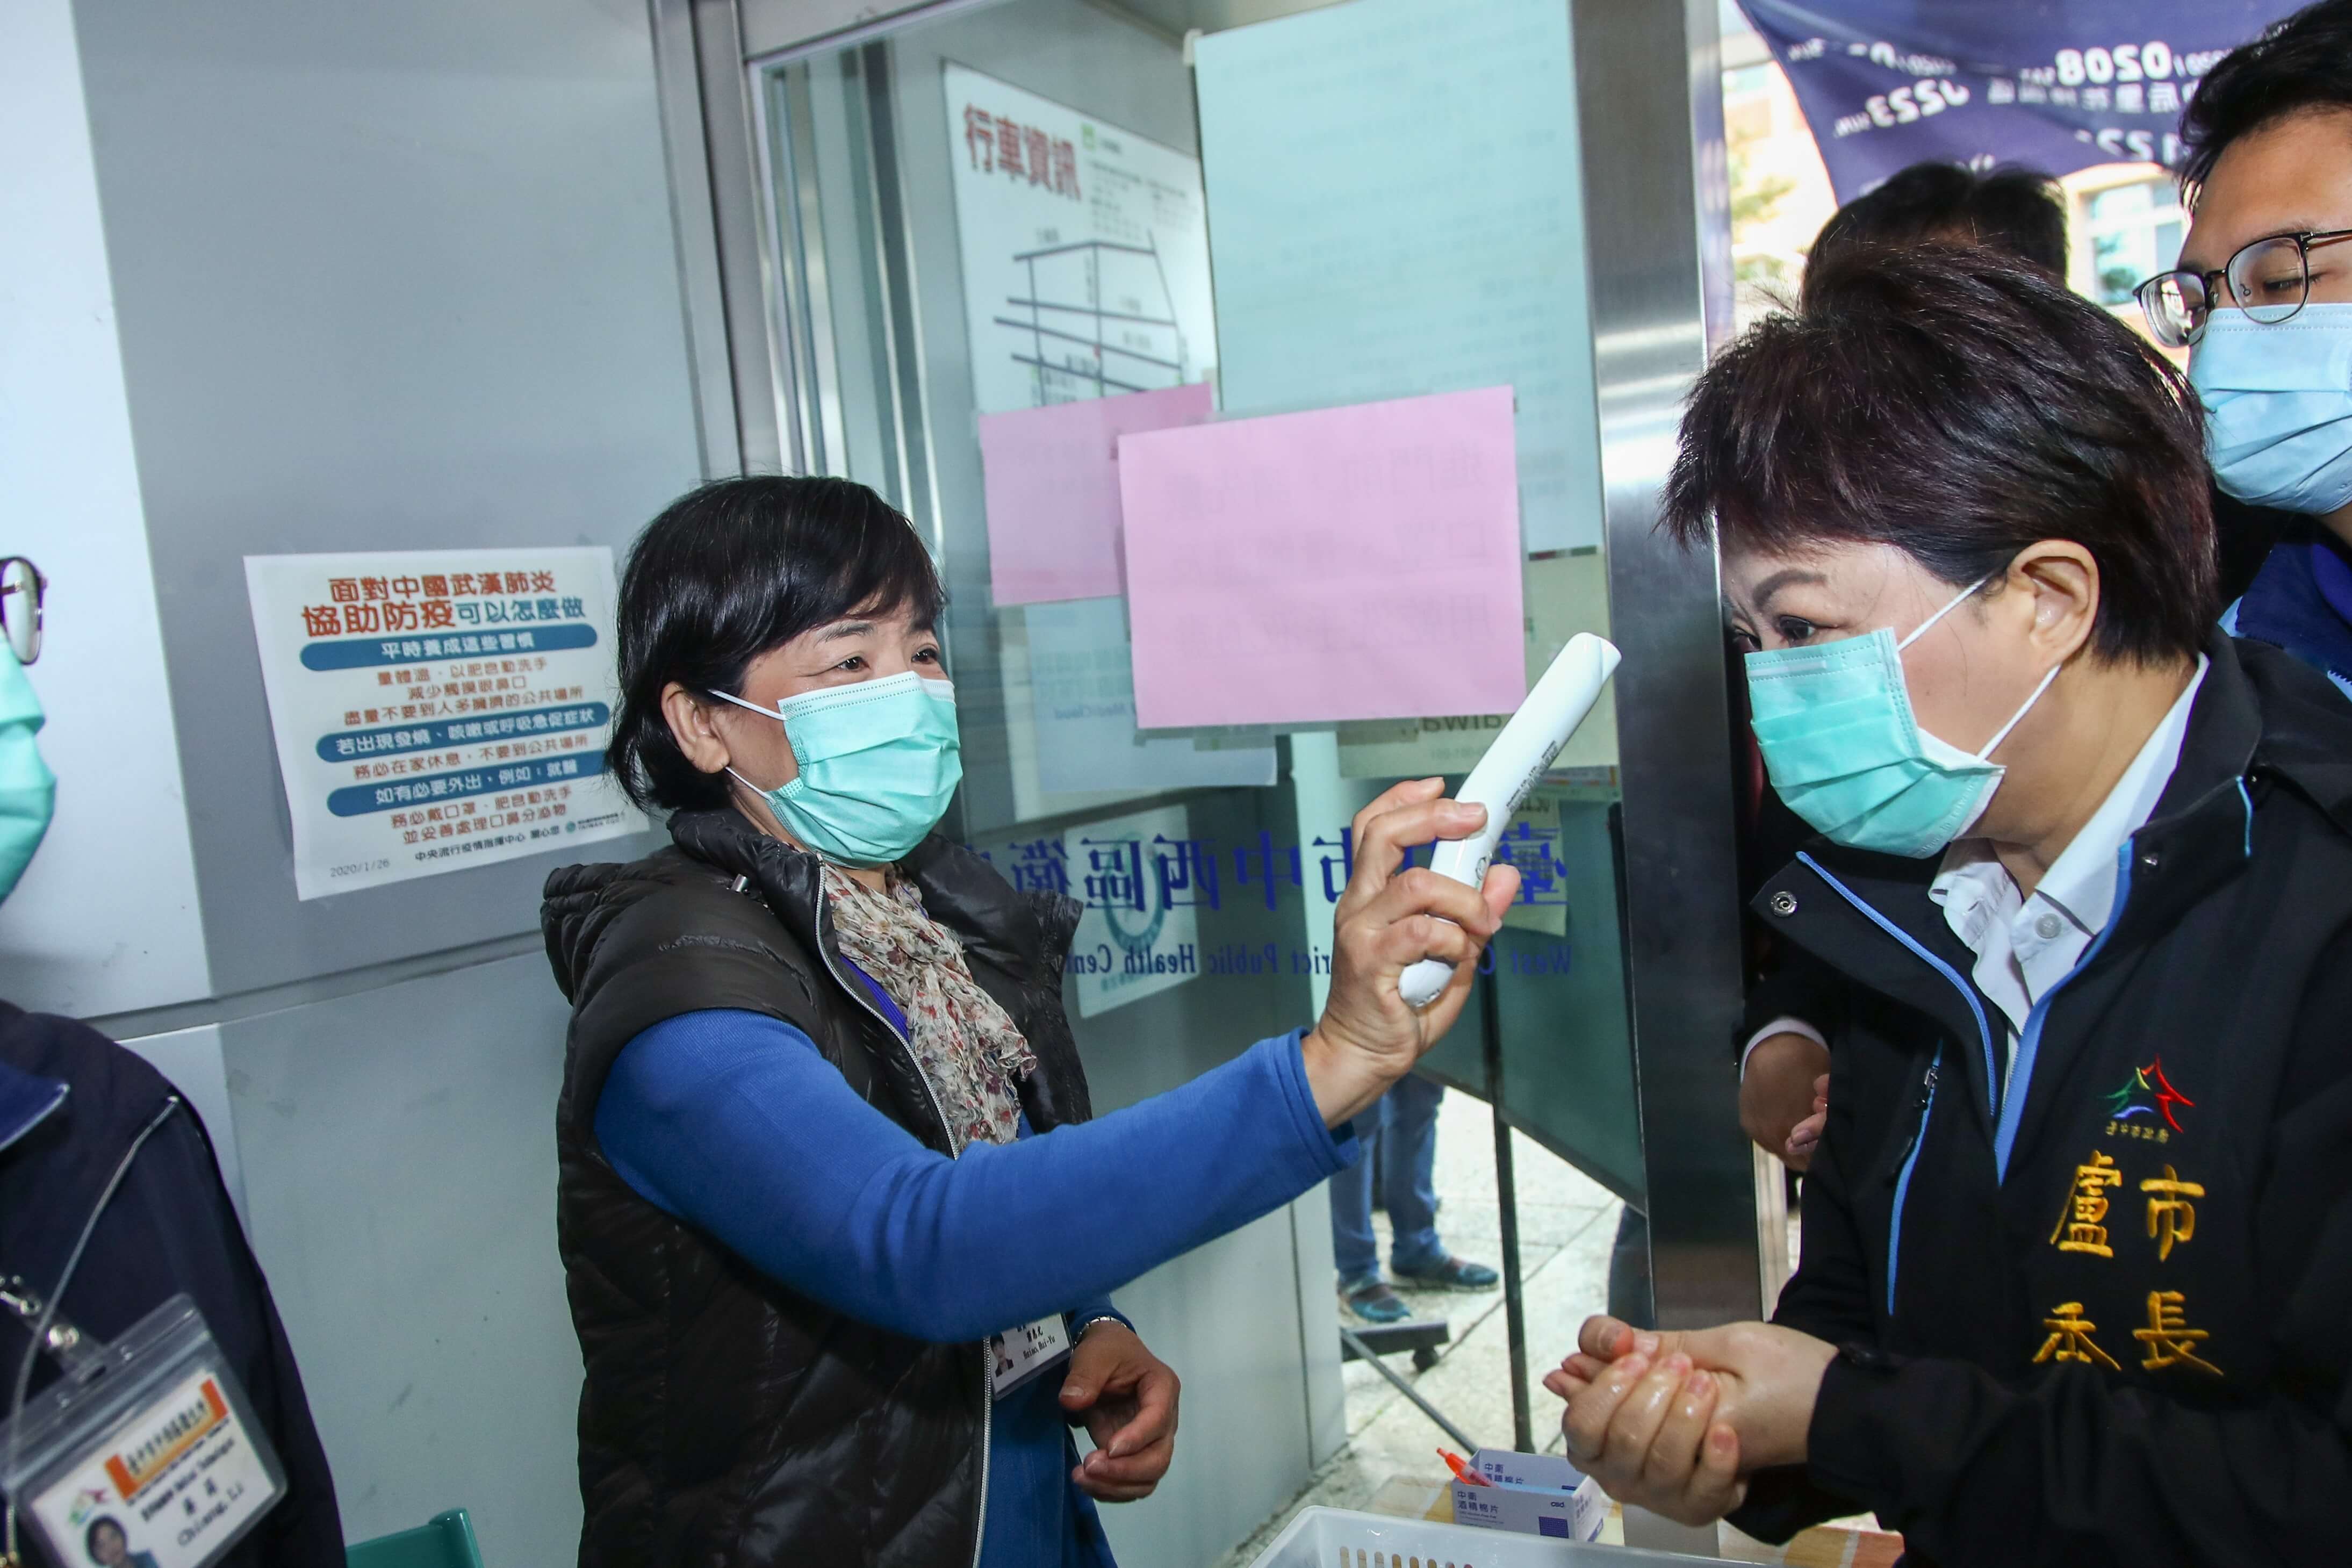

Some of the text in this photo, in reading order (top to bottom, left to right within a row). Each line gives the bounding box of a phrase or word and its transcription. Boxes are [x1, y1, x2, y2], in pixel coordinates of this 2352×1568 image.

[963, 102, 1081, 203] 行車資訊
[327, 570, 557, 602] 面對中國武漢肺炎
[301, 596, 586, 637] 協助防疫可以怎麼做
[381, 631, 535, 659] 平時養成這些習慣
[415, 833, 526, 861] 中央流行疫情指揮中心
[330, 858, 391, 878] 2020/1/26
[1457, 1490, 1477, 1501] 中衛
[1457, 1500, 1499, 1514] 酒精棉片
